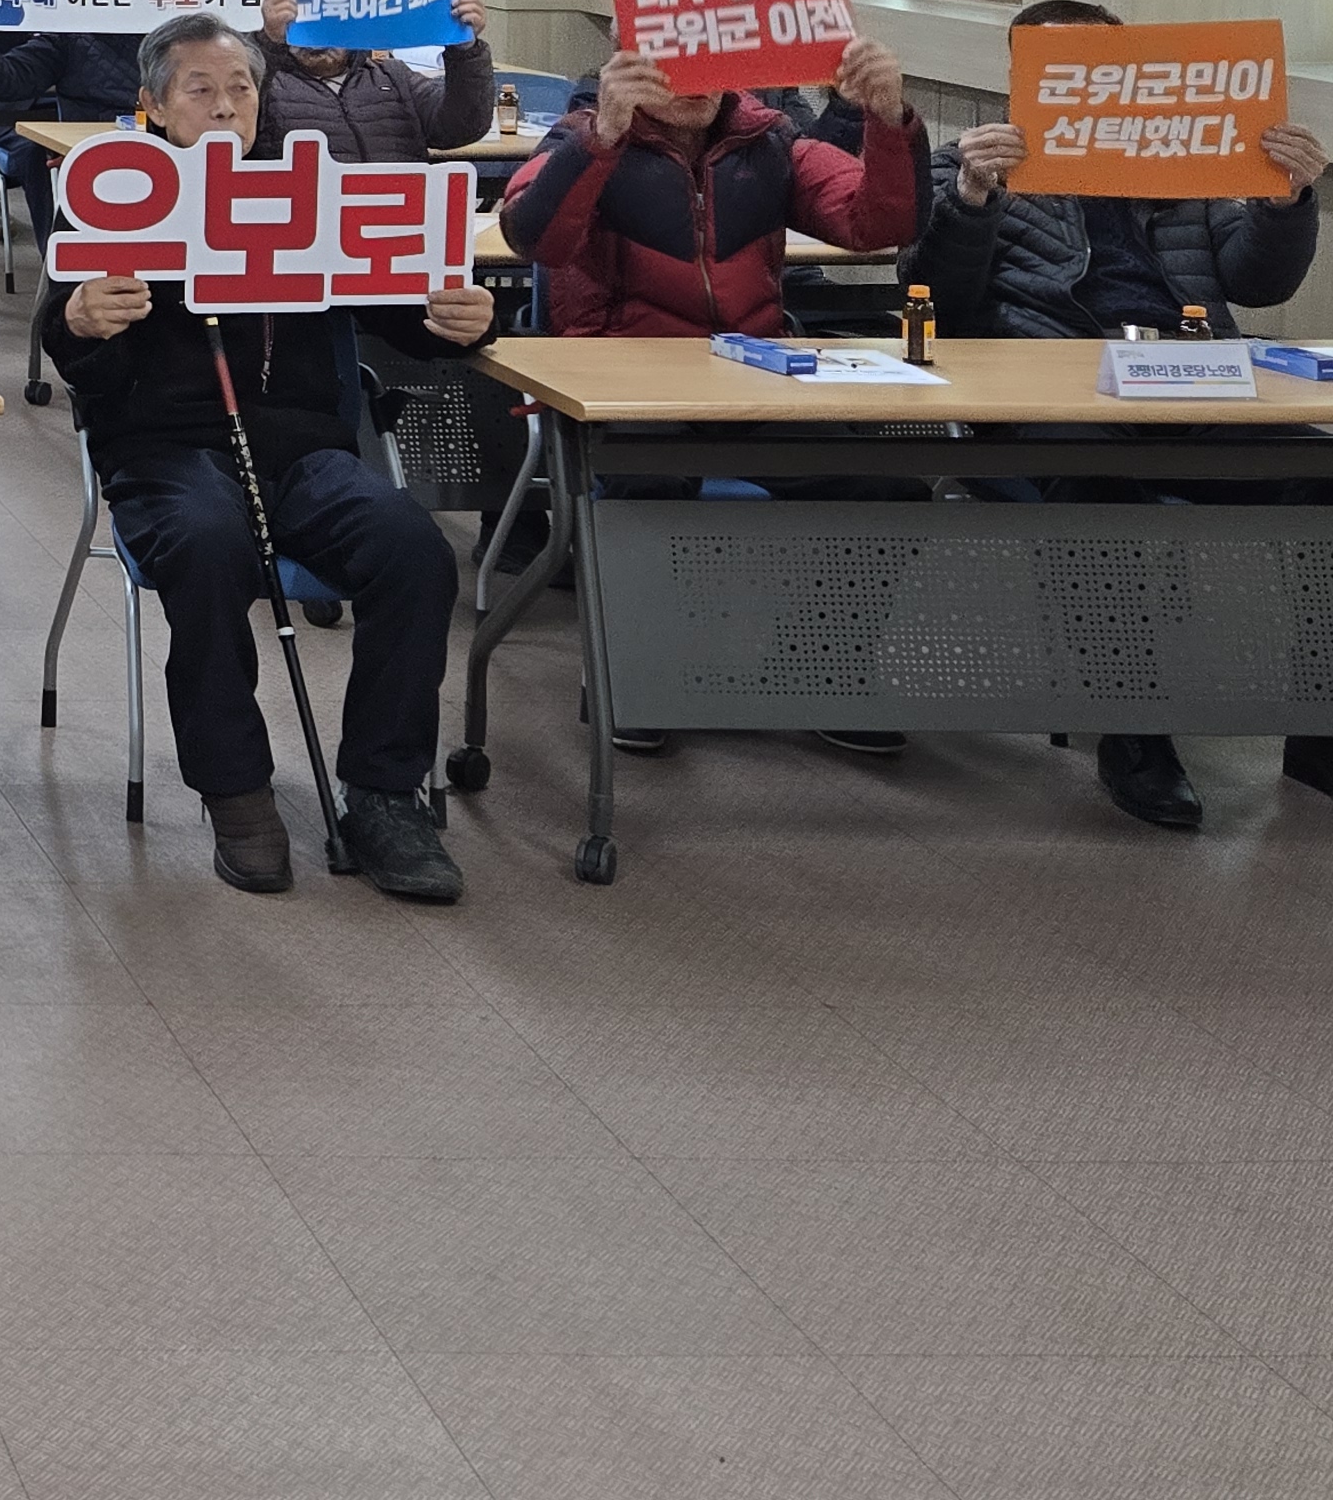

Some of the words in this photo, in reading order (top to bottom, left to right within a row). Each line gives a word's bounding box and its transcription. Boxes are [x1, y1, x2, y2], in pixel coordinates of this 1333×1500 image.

[634, 4, 761, 60] 군위군
[1037, 58, 1274, 105] 군위군민이
[1043, 114, 1245, 157] 선택했다.
[55, 140, 469, 304] 우보로!
